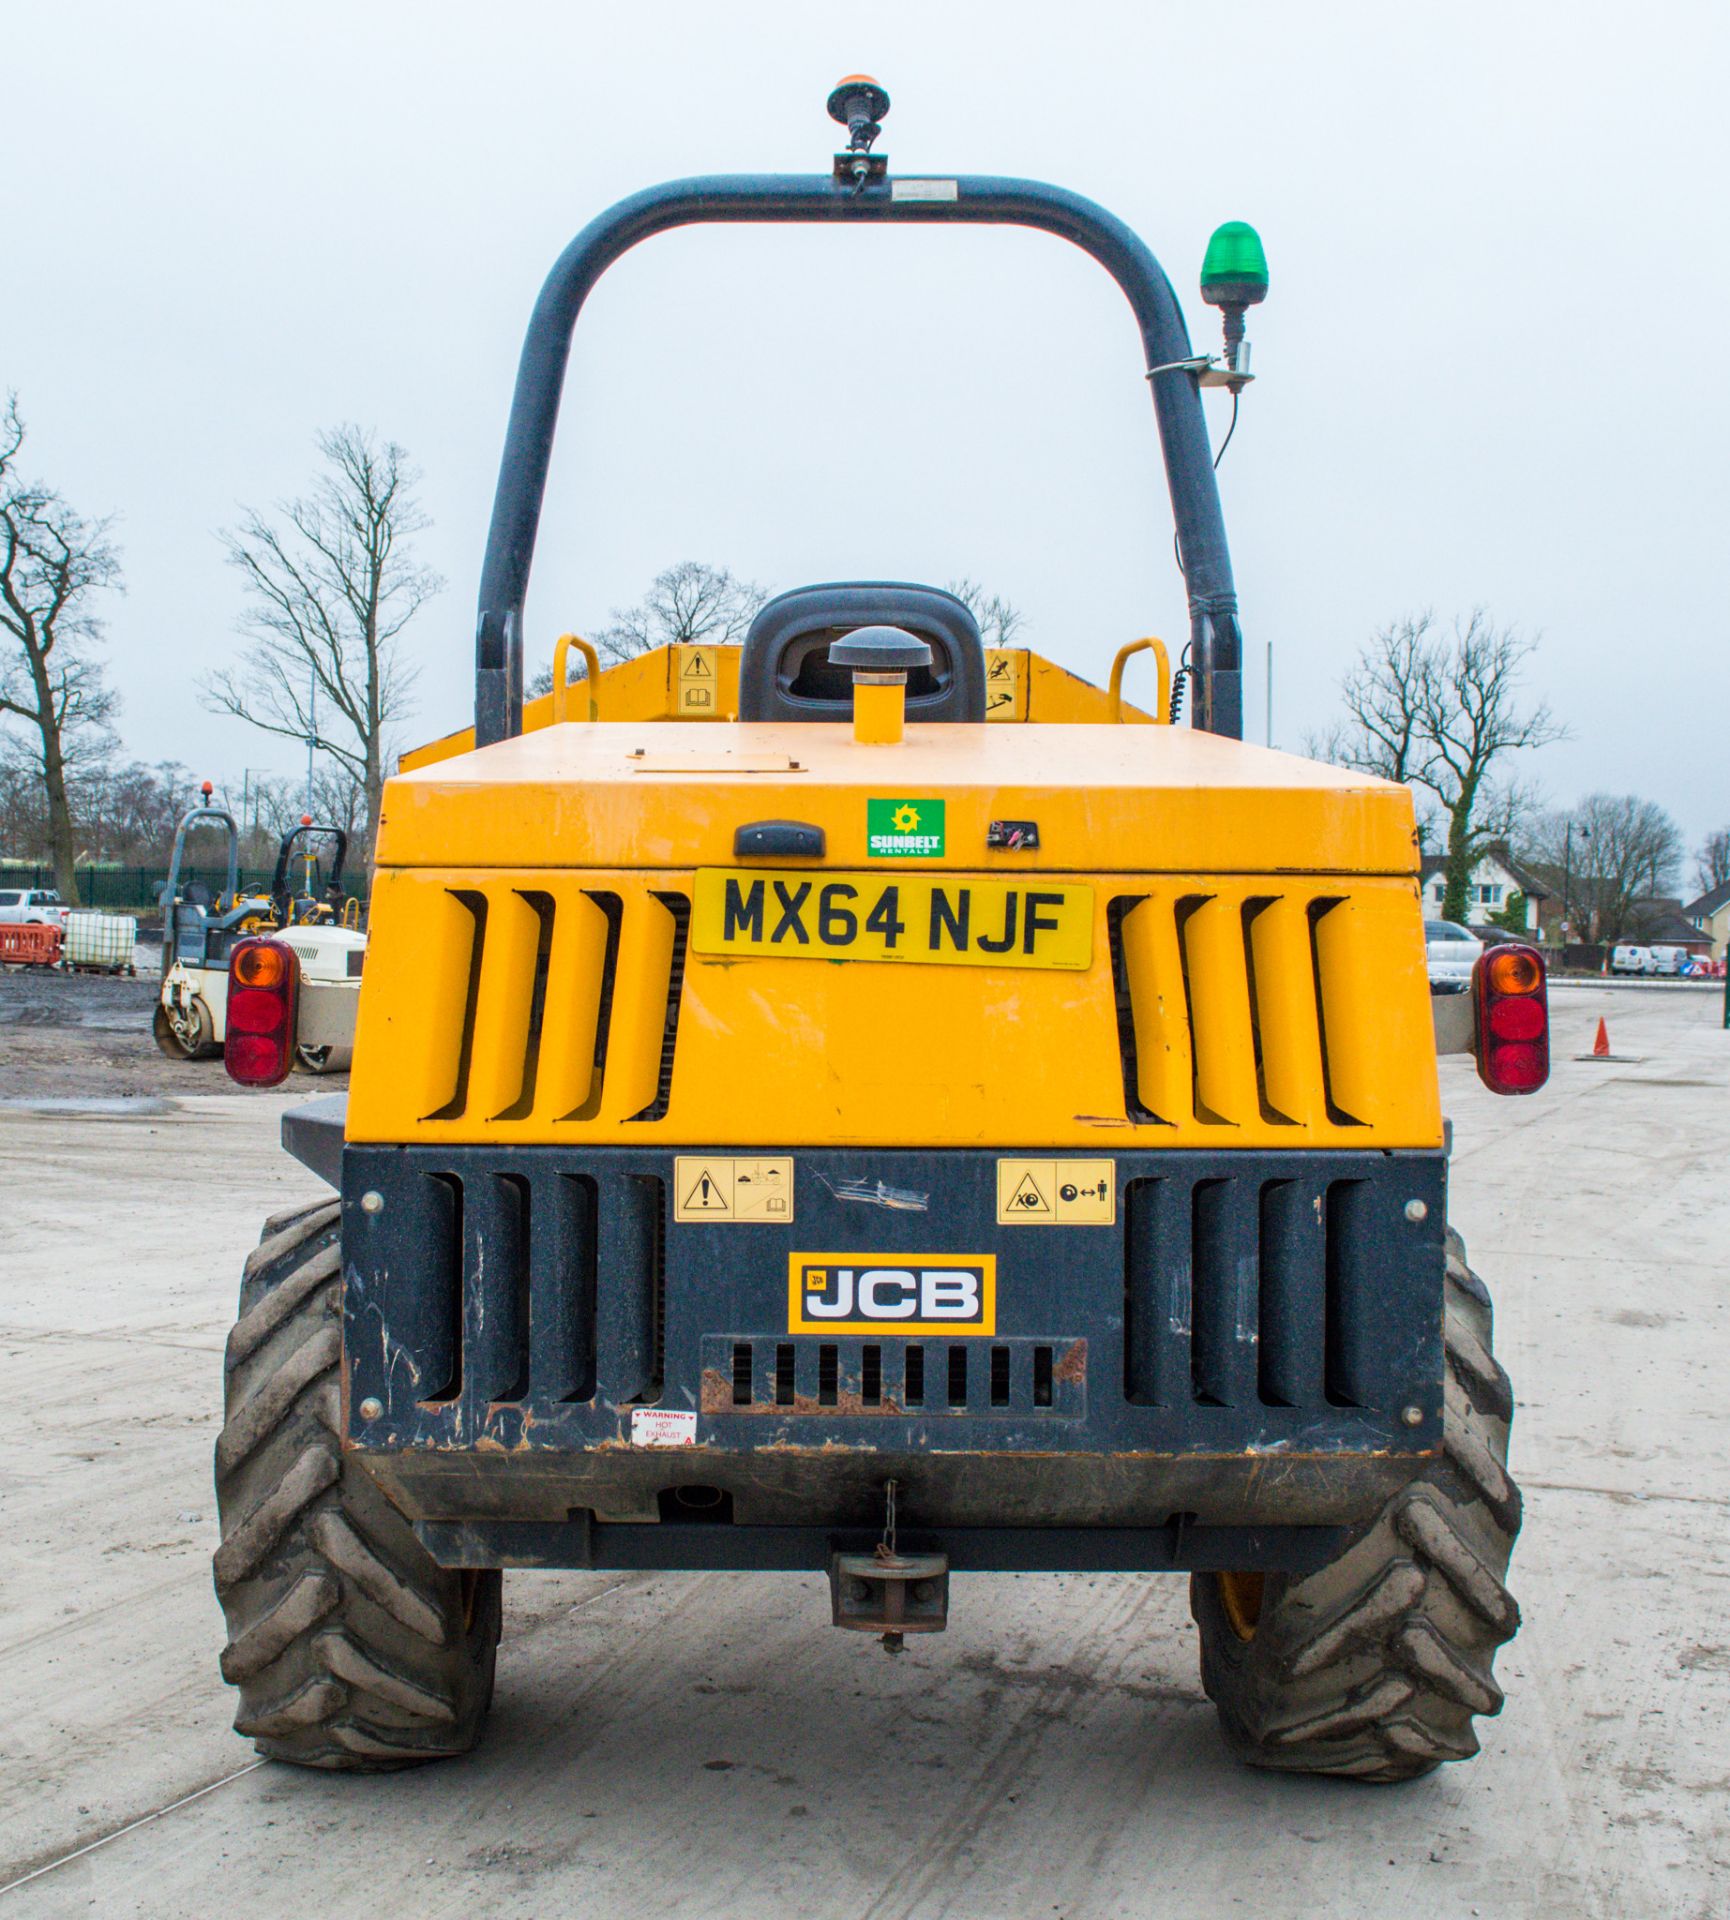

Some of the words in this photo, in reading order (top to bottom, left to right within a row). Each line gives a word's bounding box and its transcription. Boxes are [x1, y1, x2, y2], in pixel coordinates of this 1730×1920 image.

[870, 835, 940, 849] SUNBELT
[723, 878, 905, 949] MX64
[928, 887, 1064, 954] NJF
[806, 1270, 979, 1318] JCB
[643, 1411, 686, 1420] WARNING
[655, 1421, 672, 1429] HOT
